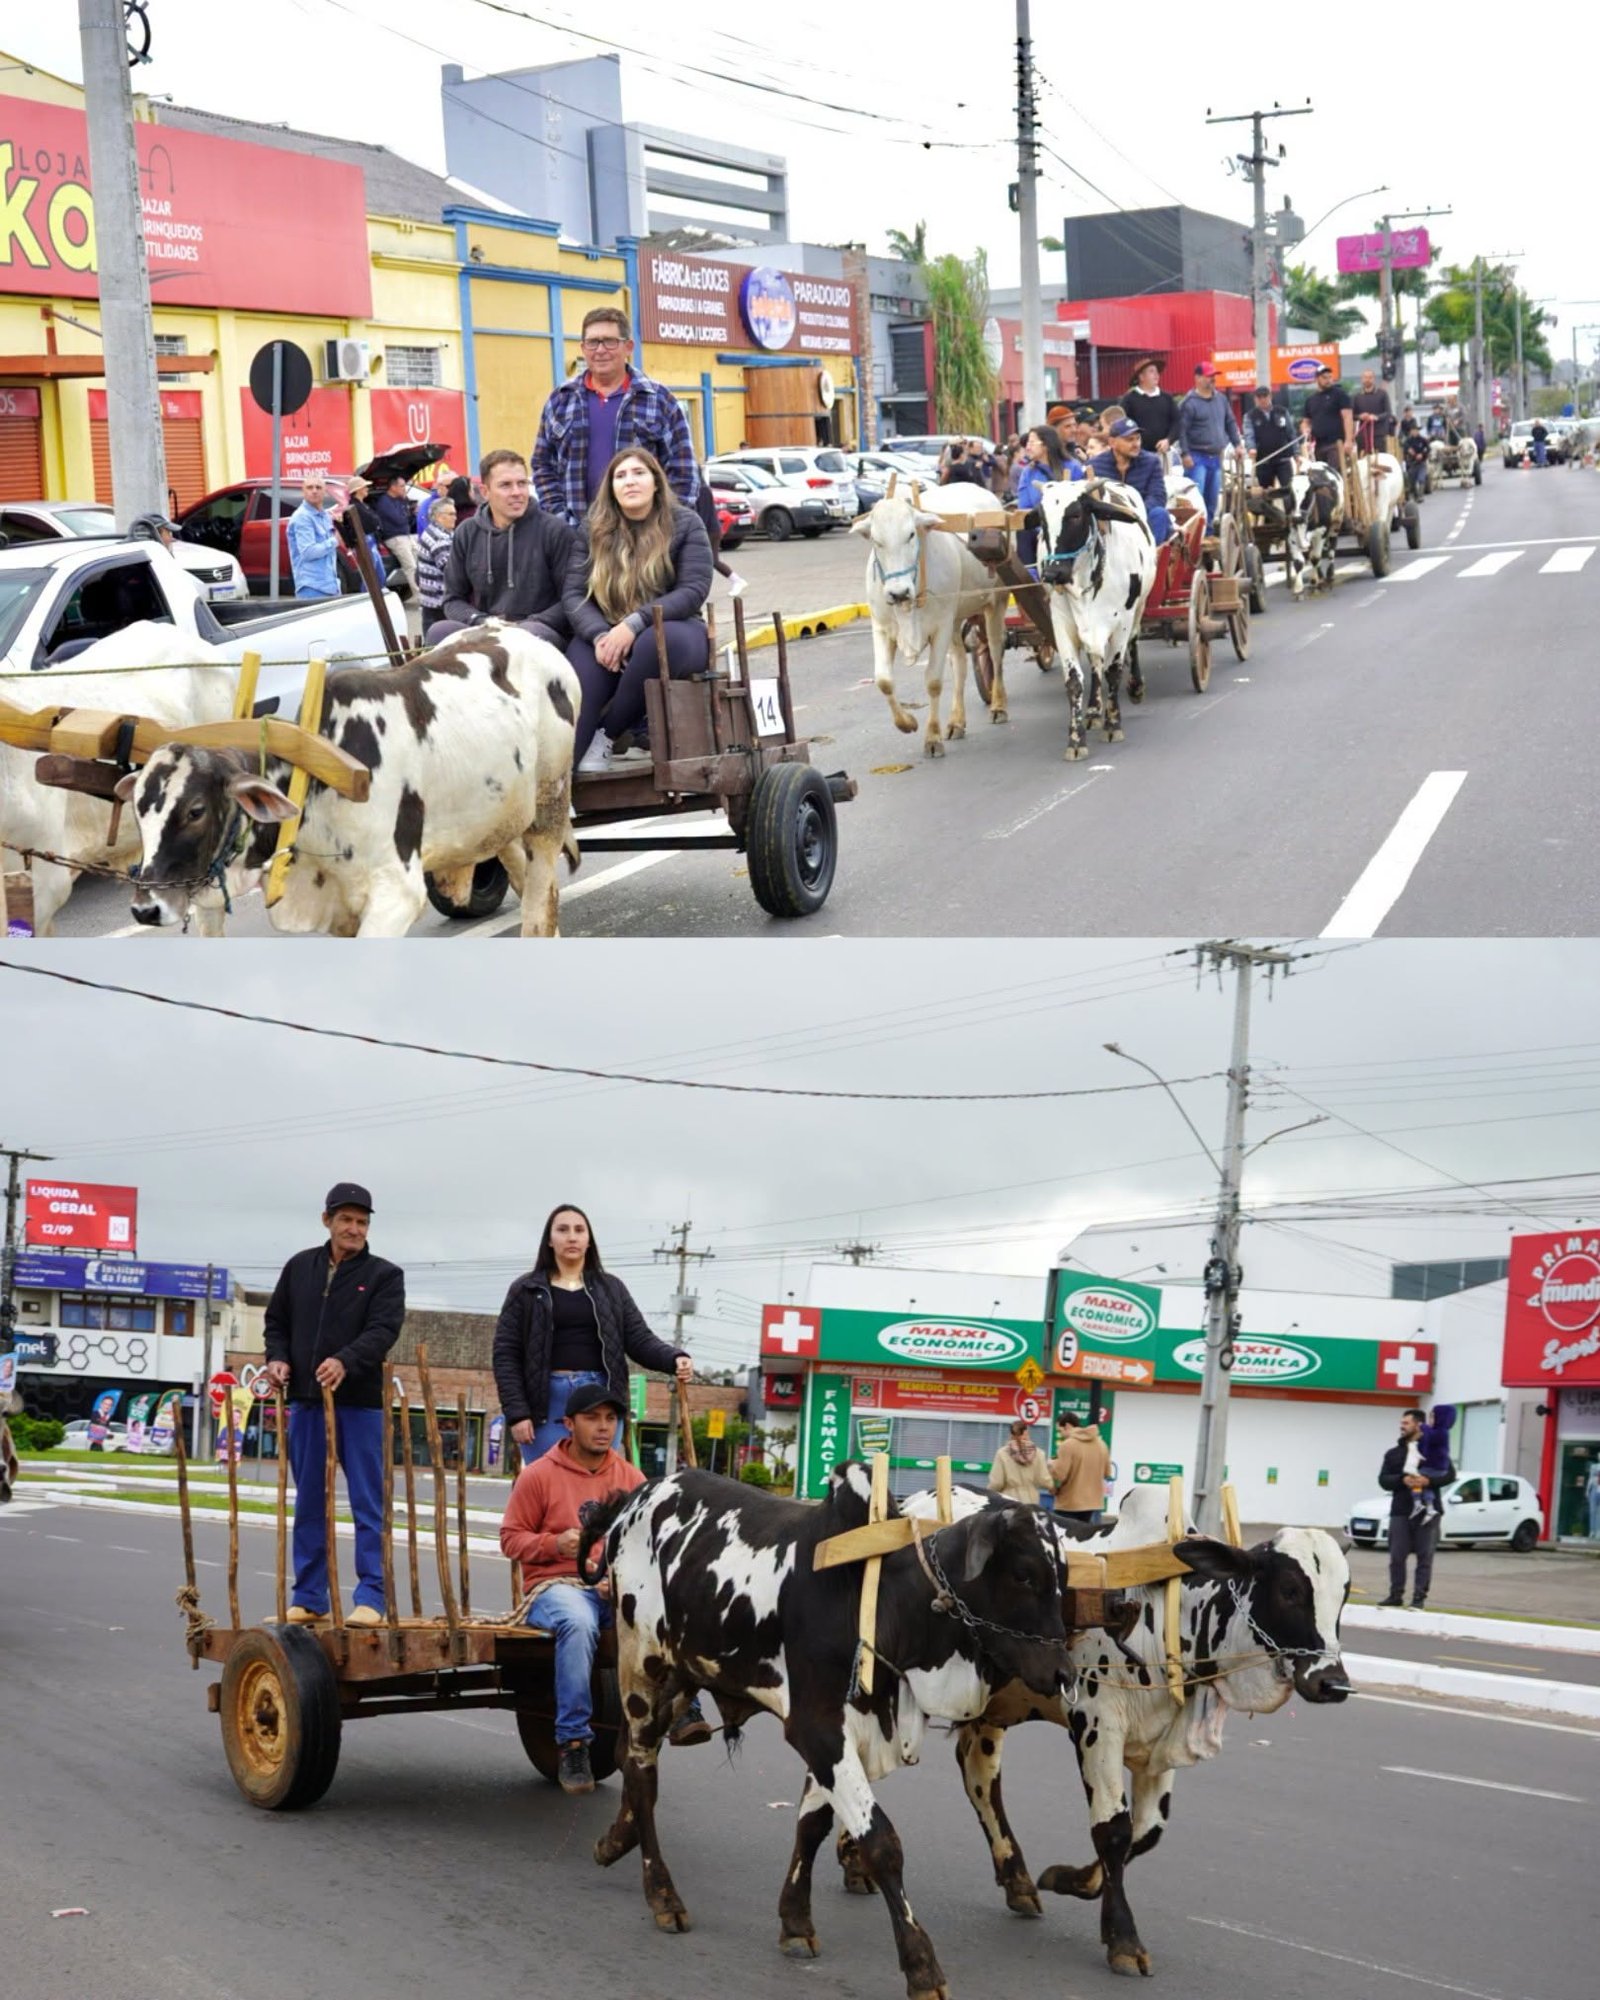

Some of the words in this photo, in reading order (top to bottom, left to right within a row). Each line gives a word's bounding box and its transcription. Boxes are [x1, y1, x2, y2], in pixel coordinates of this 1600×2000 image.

[793, 280, 851, 308] PARADOURO
[757, 695, 777, 728] 14
[30, 1185, 80, 1199] LIQUIDA
[49, 1201, 97, 1216] GERAL
[41, 1223, 74, 1235] 12/09
[1531, 1236, 1600, 1281] PRIMA
[1083, 1295, 1134, 1313] MAXXI
[1069, 1305, 1144, 1329] ECONÔMICA
[909, 1326, 989, 1339] MAXXI
[888, 1336, 1007, 1352] ECONÔMICA
[1062, 1336, 1074, 1362] E
[1231, 1344, 1282, 1356] AXXI
[1183, 1352, 1301, 1368] ECÔMICA
